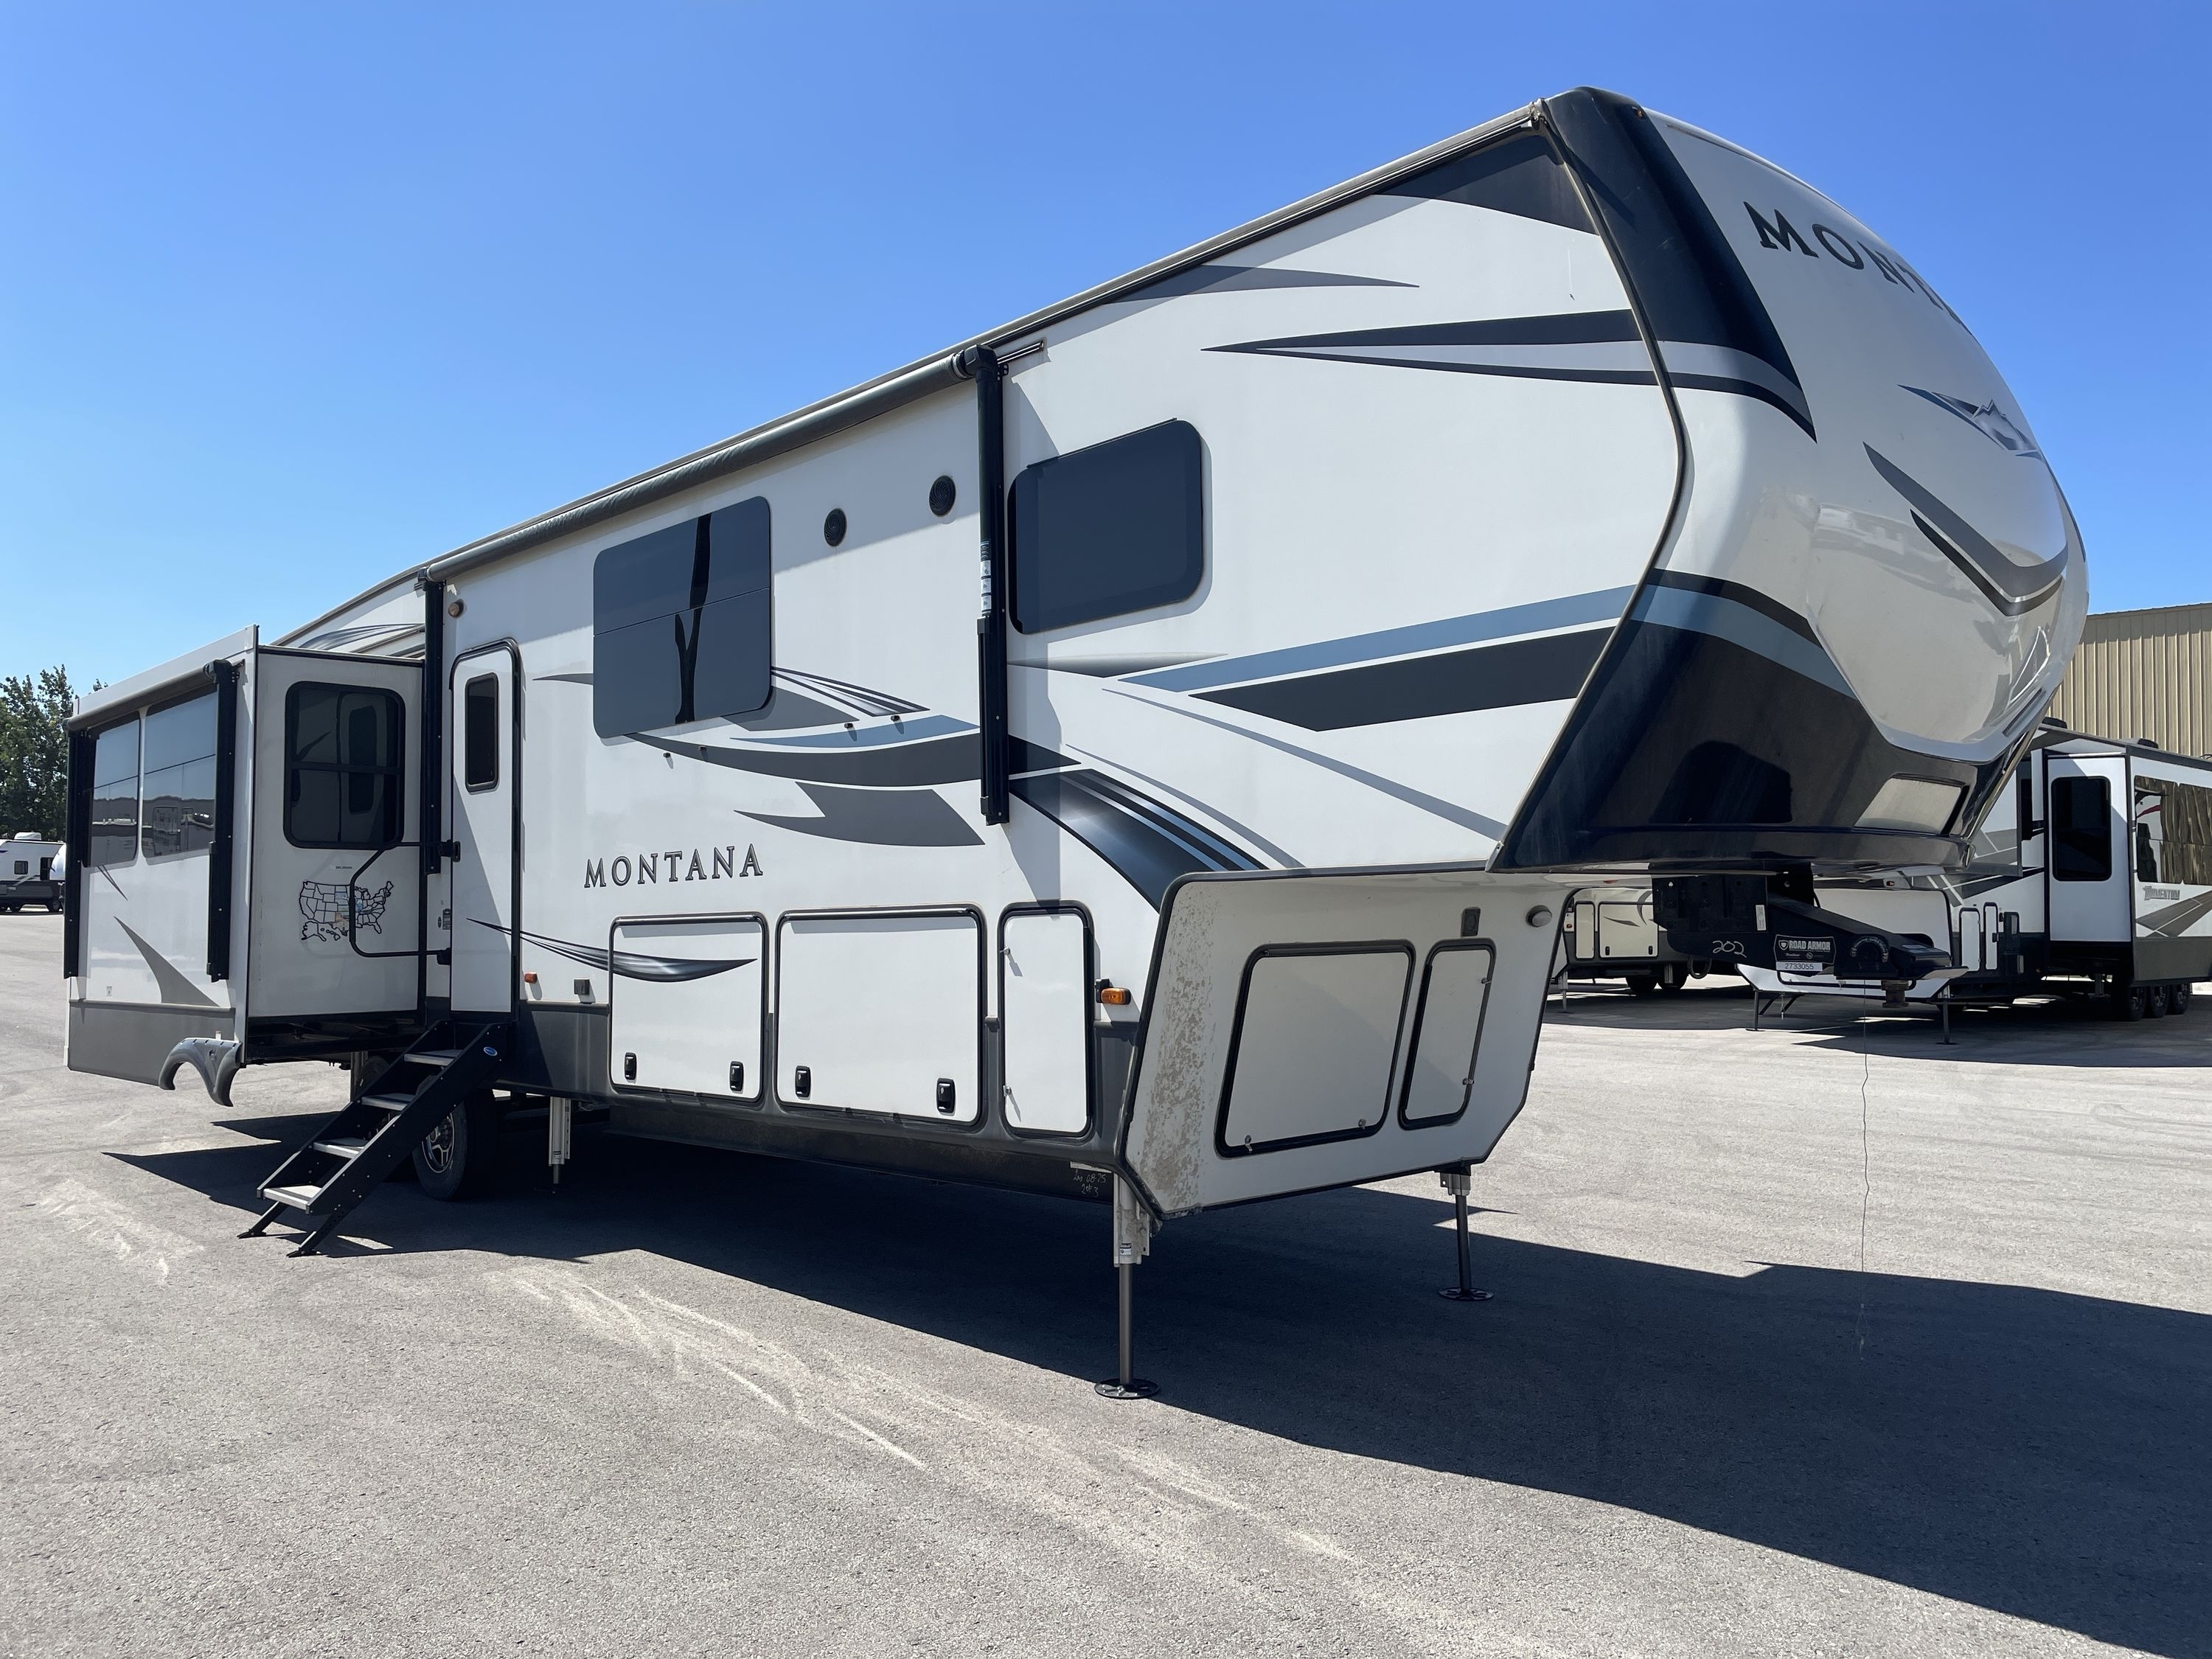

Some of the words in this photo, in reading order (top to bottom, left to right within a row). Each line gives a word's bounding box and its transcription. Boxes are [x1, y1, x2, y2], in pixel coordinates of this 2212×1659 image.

[1743, 201, 1963, 327] MONT
[584, 843, 764, 888] MONTANA
[1712, 940, 1747, 959] 202
[1789, 940, 1806, 950] ROAD
[1807, 941, 1831, 951] ARMOR
[1784, 962, 1815, 970] 2733055
